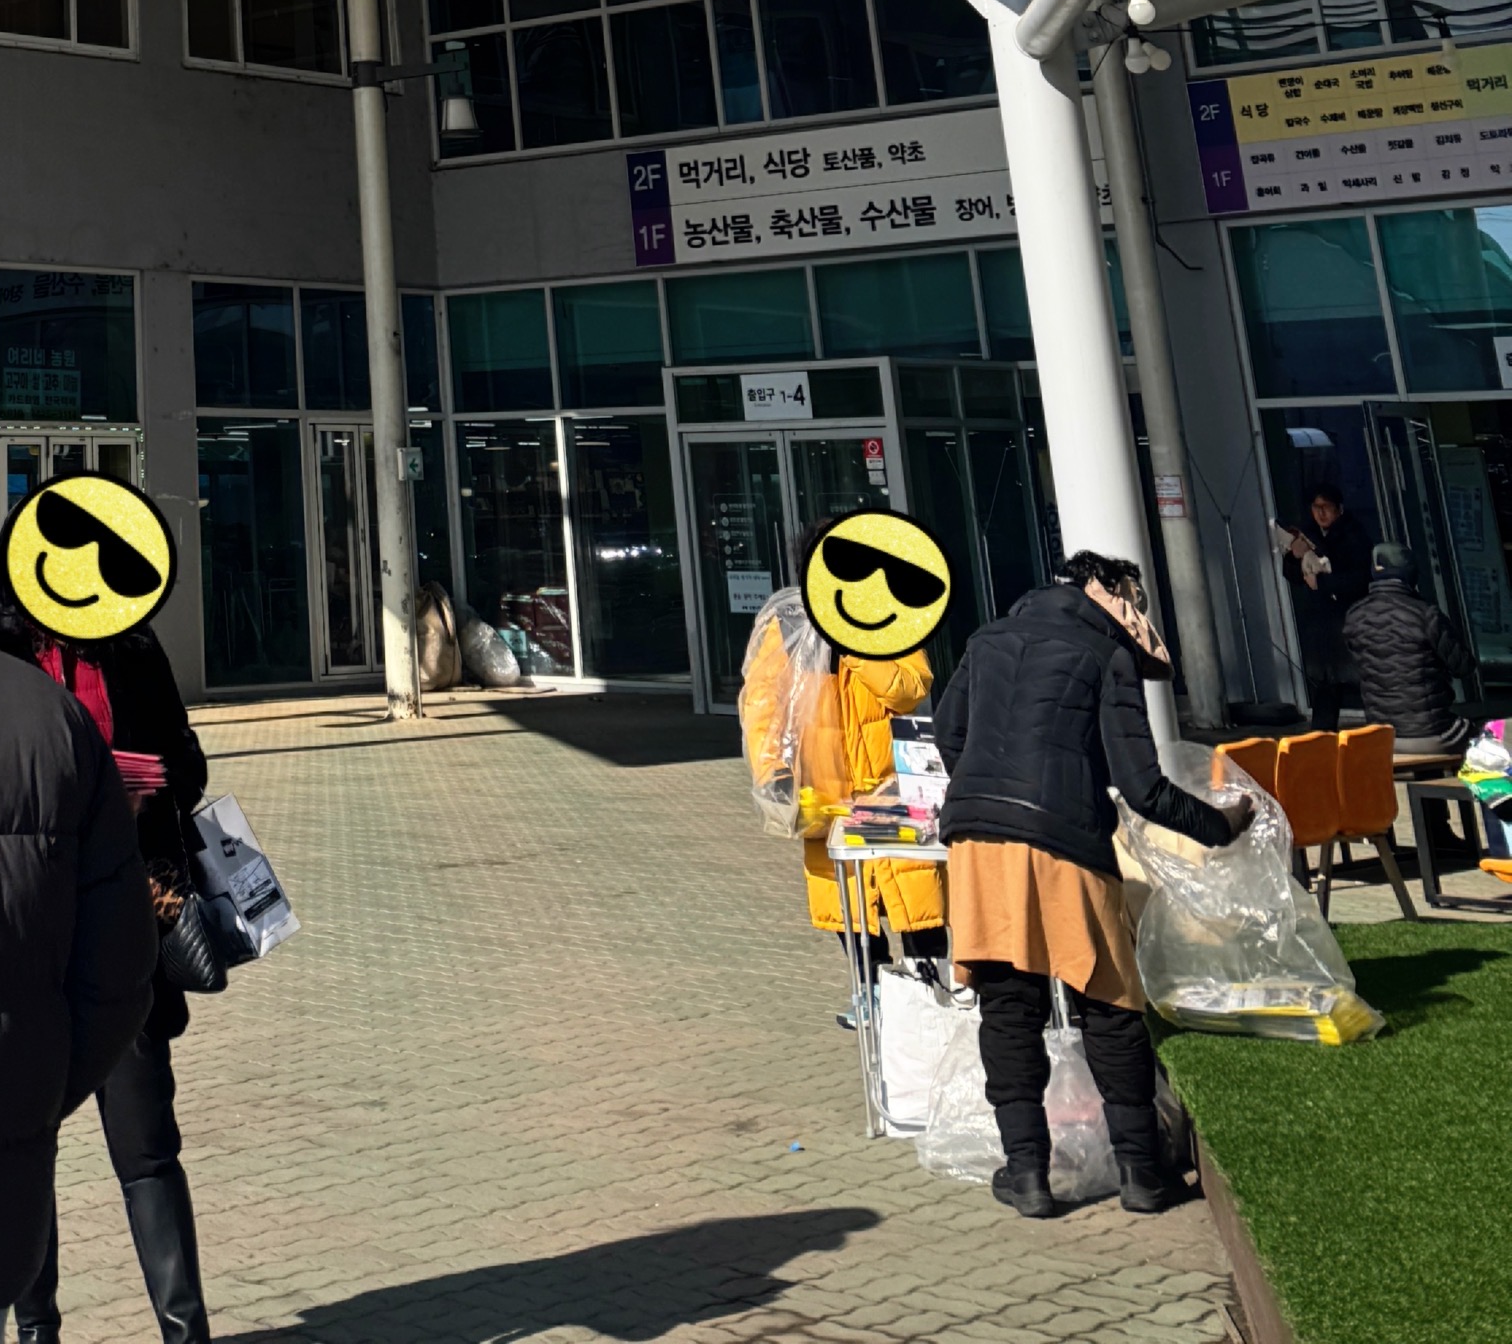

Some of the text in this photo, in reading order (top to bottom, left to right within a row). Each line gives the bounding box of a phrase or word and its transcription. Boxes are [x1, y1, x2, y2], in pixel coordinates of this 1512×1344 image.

[1466, 74, 1509, 92] 먹거리
[1200, 105, 1220, 121] 2F
[678, 140, 926, 189] 먹거리, 식당 토산품, 약초
[634, 164, 662, 192] 2F
[1212, 171, 1231, 187] 1F
[683, 212, 761, 249] 농산물,
[769, 204, 851, 240] 축산물,
[860, 195, 937, 231] 수산물
[955, 197, 1001, 222] 장어,
[638, 224, 665, 250] 1F
[7, 346, 76, 368] 여리네 농원
[747, 384, 806, 406] 출입구 1-4
